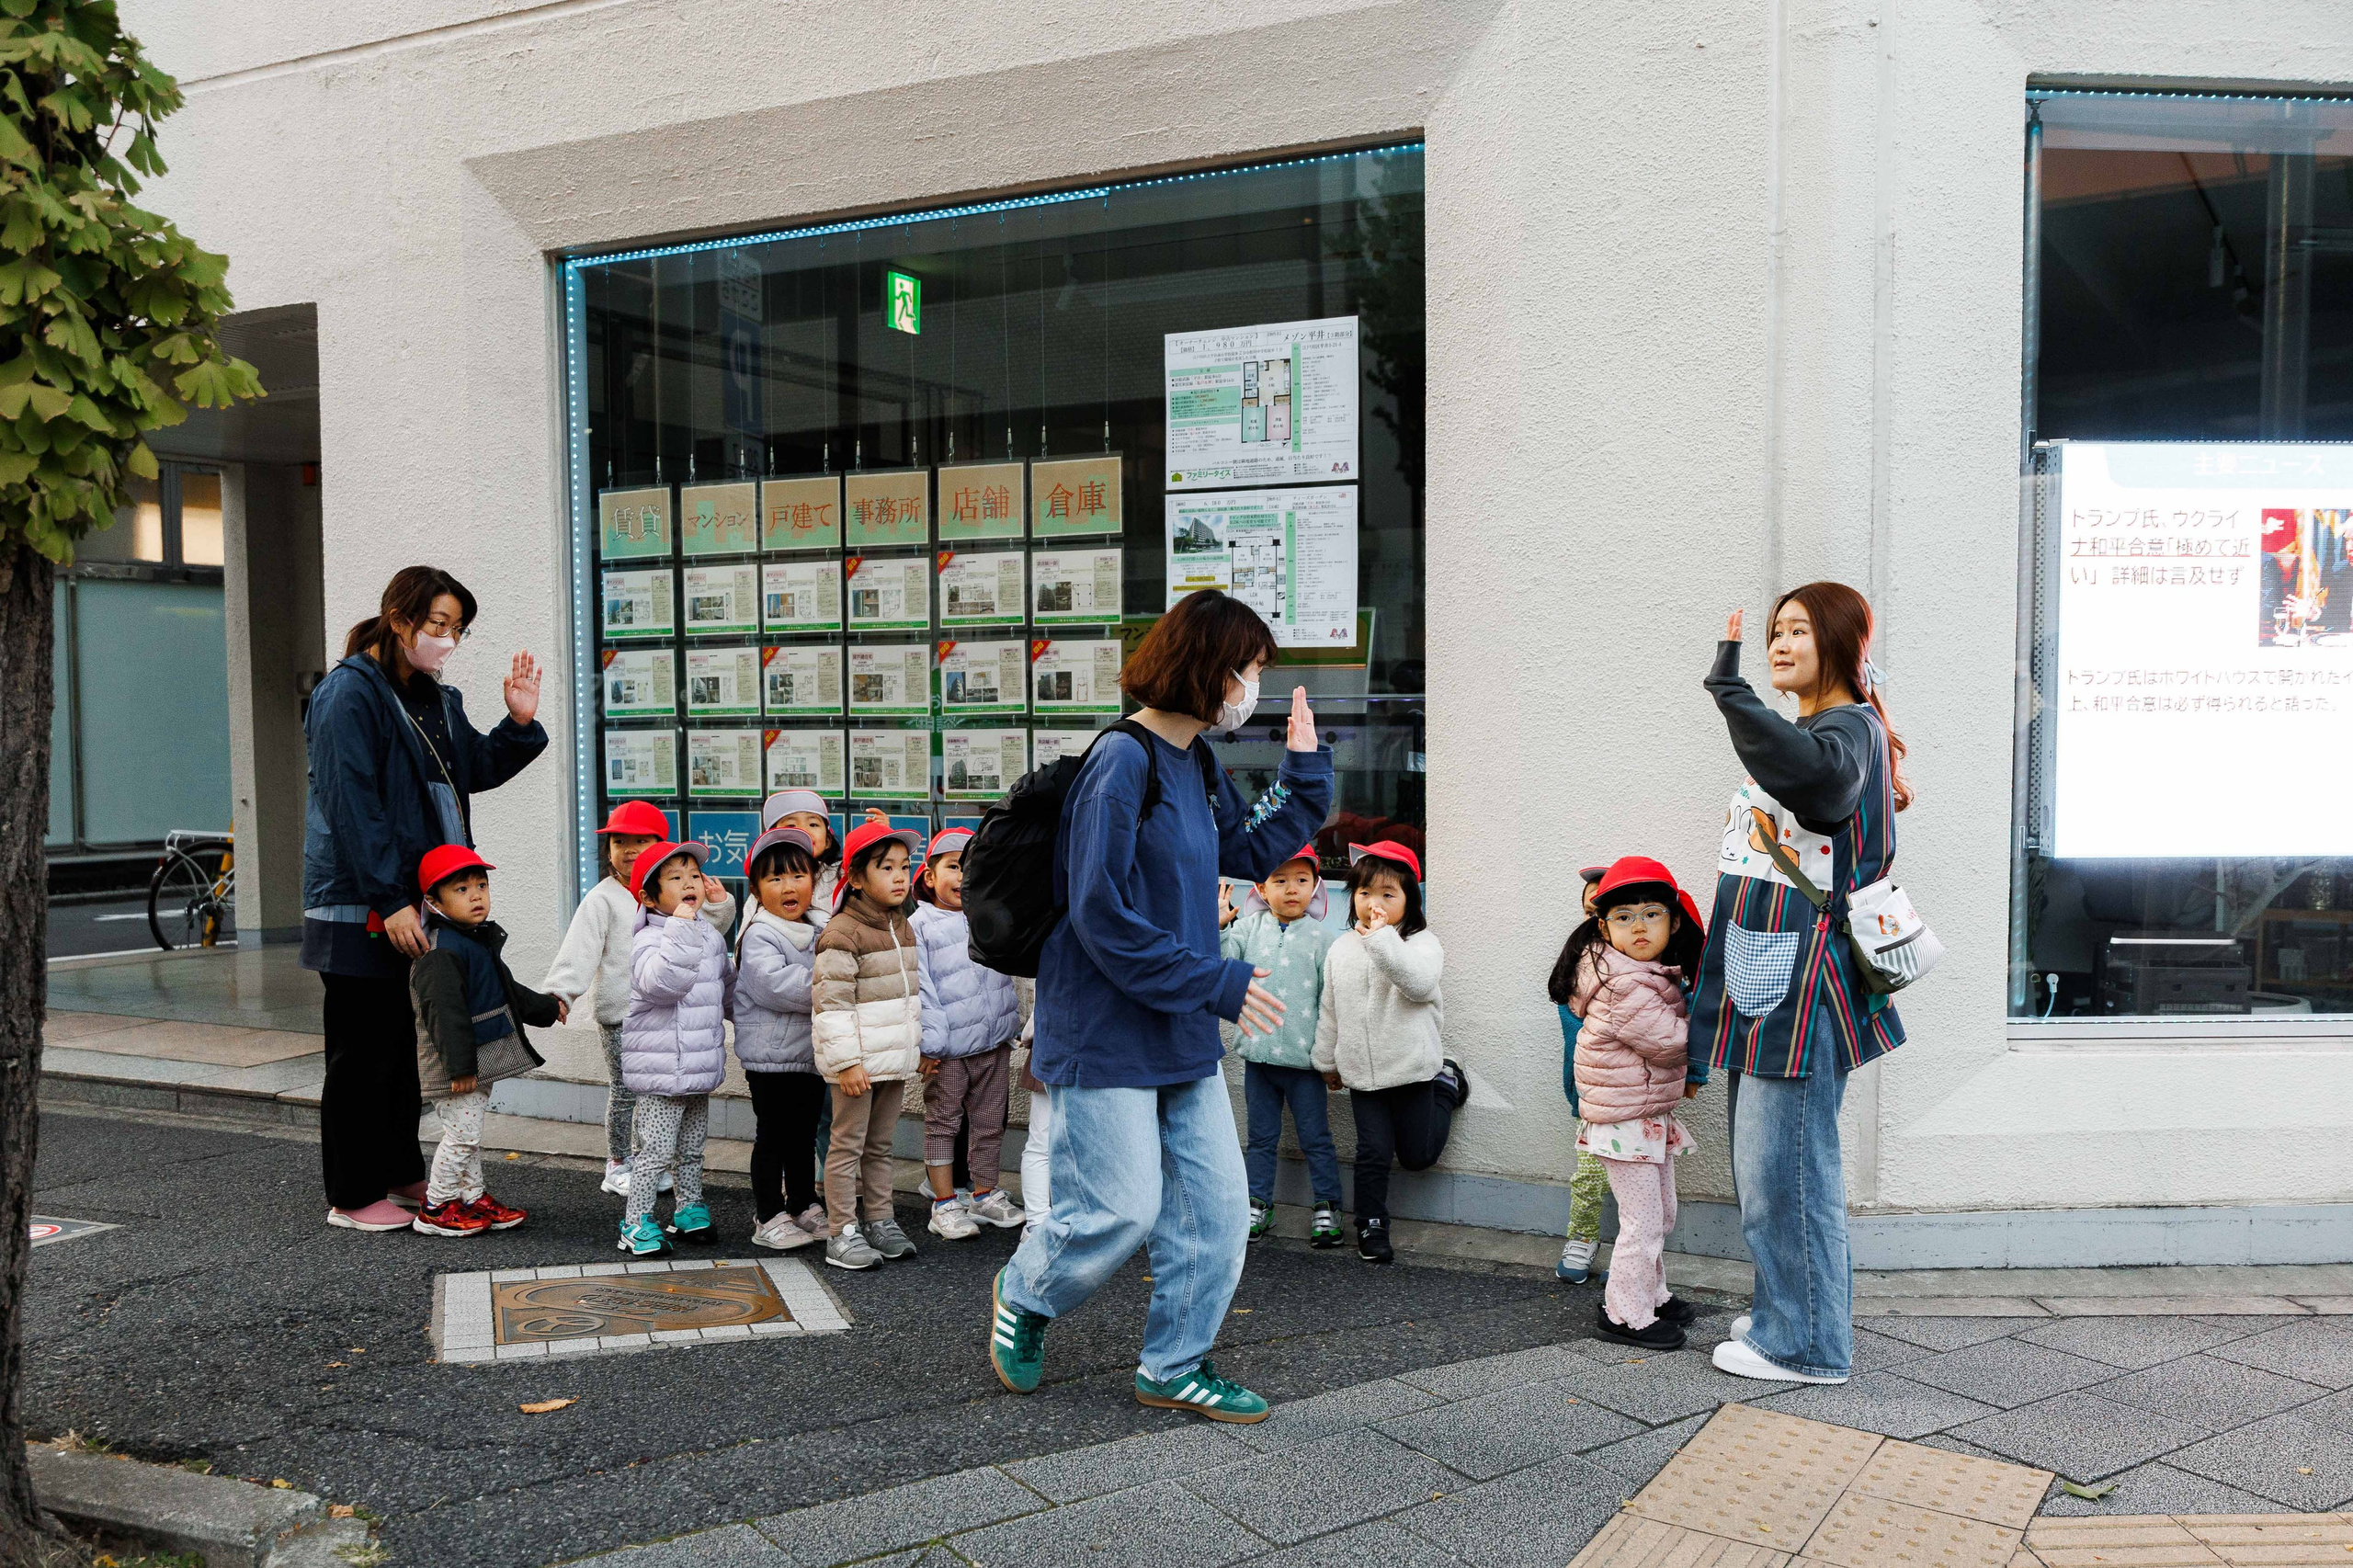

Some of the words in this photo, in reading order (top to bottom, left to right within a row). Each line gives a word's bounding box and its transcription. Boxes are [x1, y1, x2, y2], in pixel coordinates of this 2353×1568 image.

[2192, 452, 2325, 475] 主要ニュース
[852, 496, 922, 526] 事務所
[952, 484, 1009, 521] 店舗
[1045, 480, 1107, 518] 倉庫
[611, 505, 661, 541] 賃貸
[688, 511, 749, 529] マンション
[769, 502, 833, 531] 戸建て
[2073, 508, 2240, 528] トランプ氏、ウクライ
[2071, 537, 2250, 556] ナ和平合意「極めて近
[2111, 566, 2245, 585] 詳細は言及せず
[699, 829, 749, 864] お気
